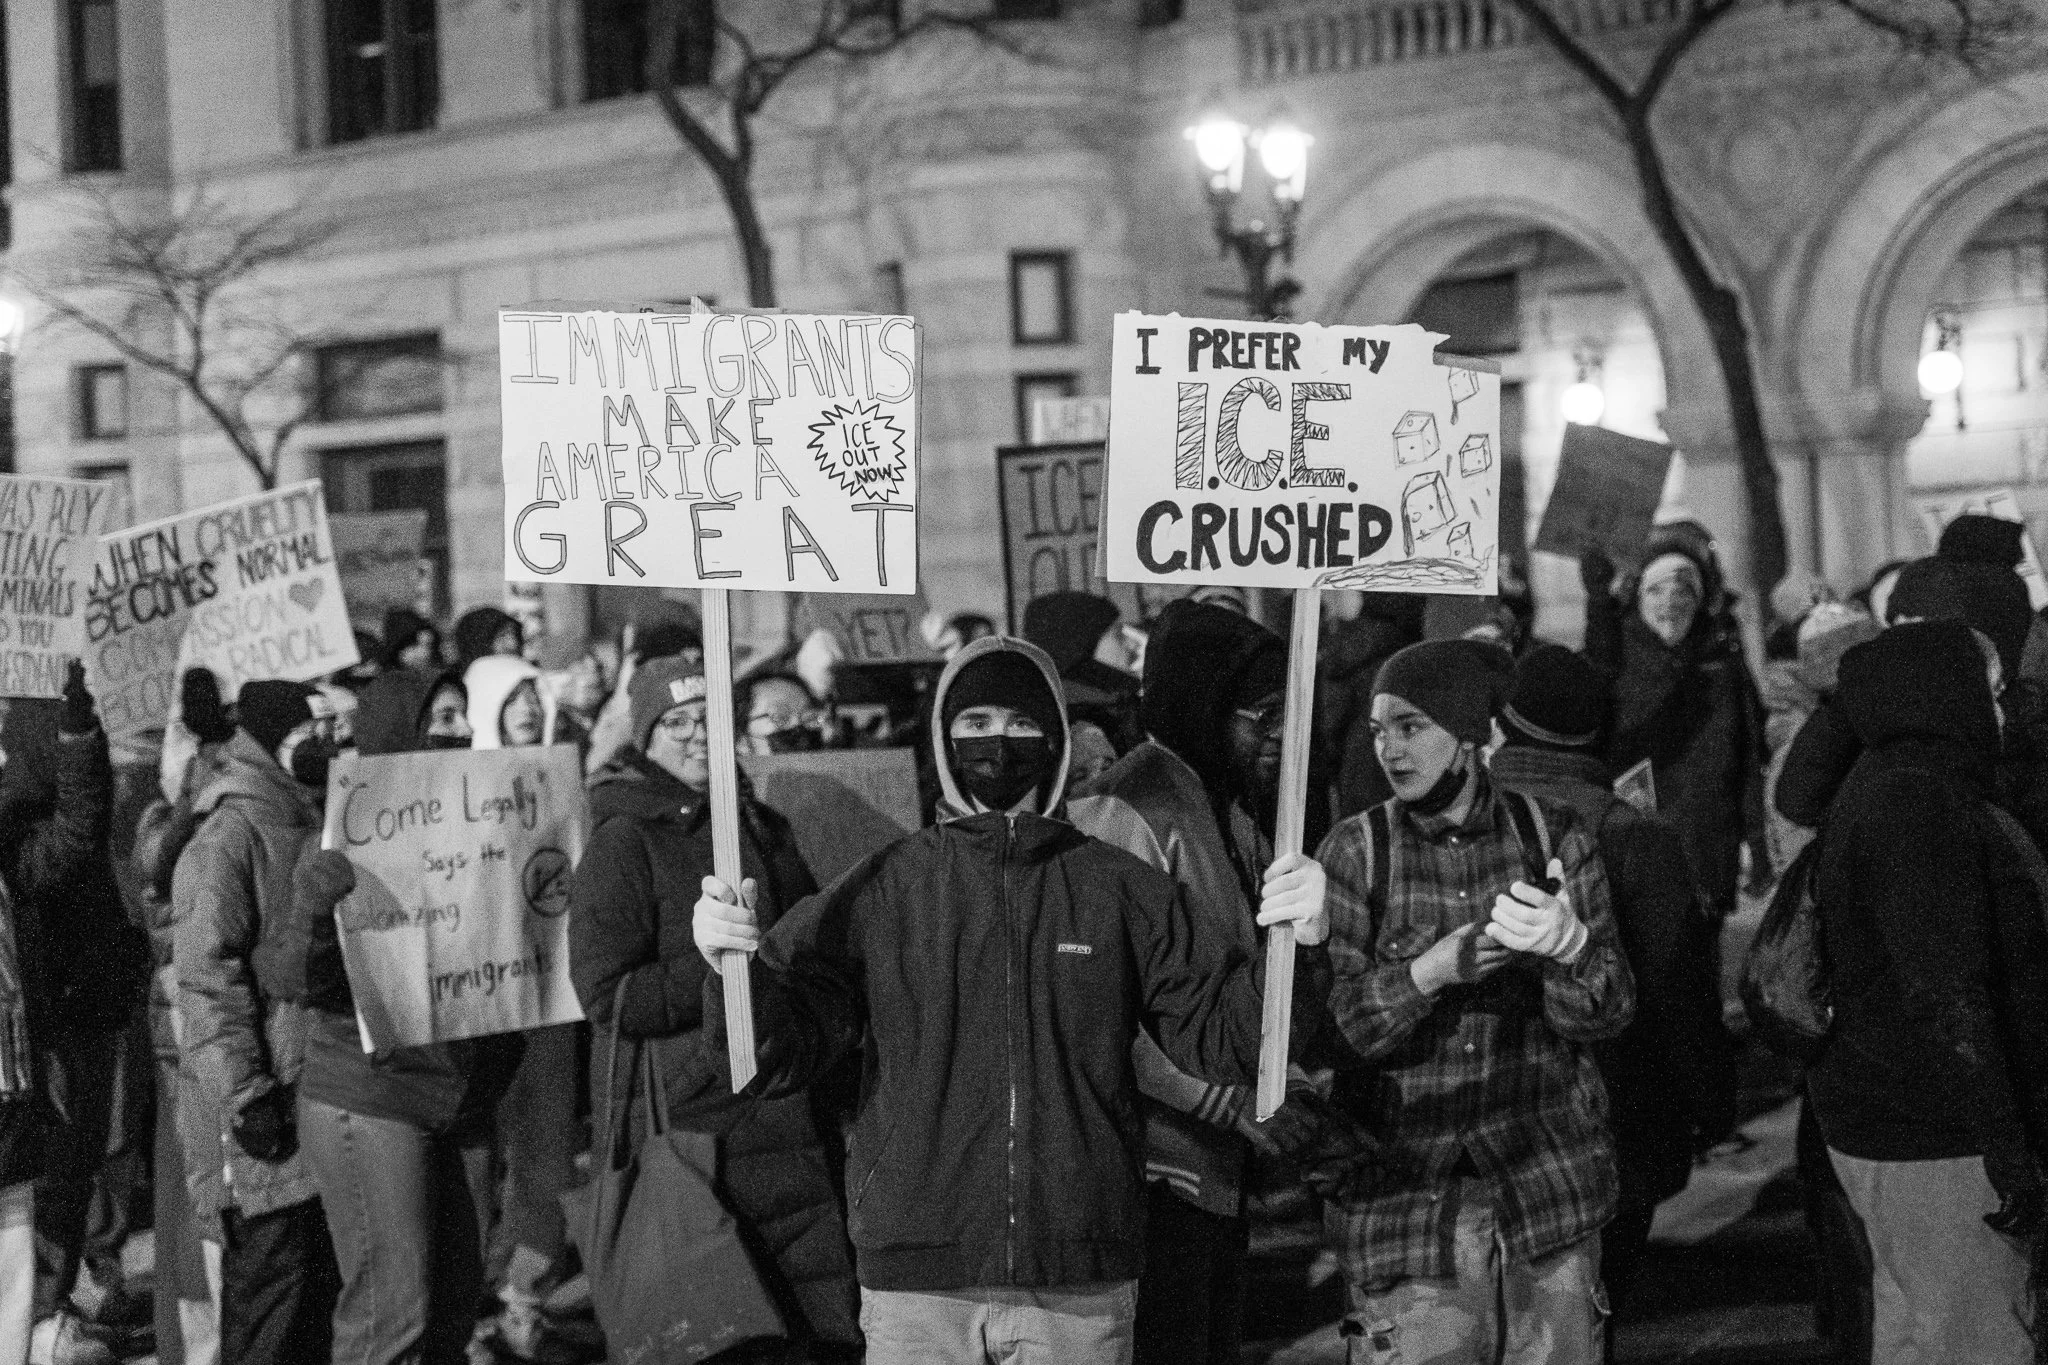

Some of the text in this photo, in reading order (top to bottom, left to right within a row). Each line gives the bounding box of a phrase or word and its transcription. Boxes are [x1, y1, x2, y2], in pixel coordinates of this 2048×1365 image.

[503, 315, 915, 404] IMMIGRANTS
[1136, 327, 1390, 374] I PREFER MY
[603, 395, 775, 447] MAKE
[843, 421, 875, 448] ICE
[1175, 376, 1359, 492] I.C.E.
[536, 442, 800, 503] AMERICA
[843, 446, 880, 467] OUT
[855, 463, 892, 485] NOW
[514, 501, 914, 587] GREAT
[1136, 500, 1392, 574] CRUSHED
[86, 560, 218, 642] BECOMES
[236, 532, 329, 589] NORMAL
